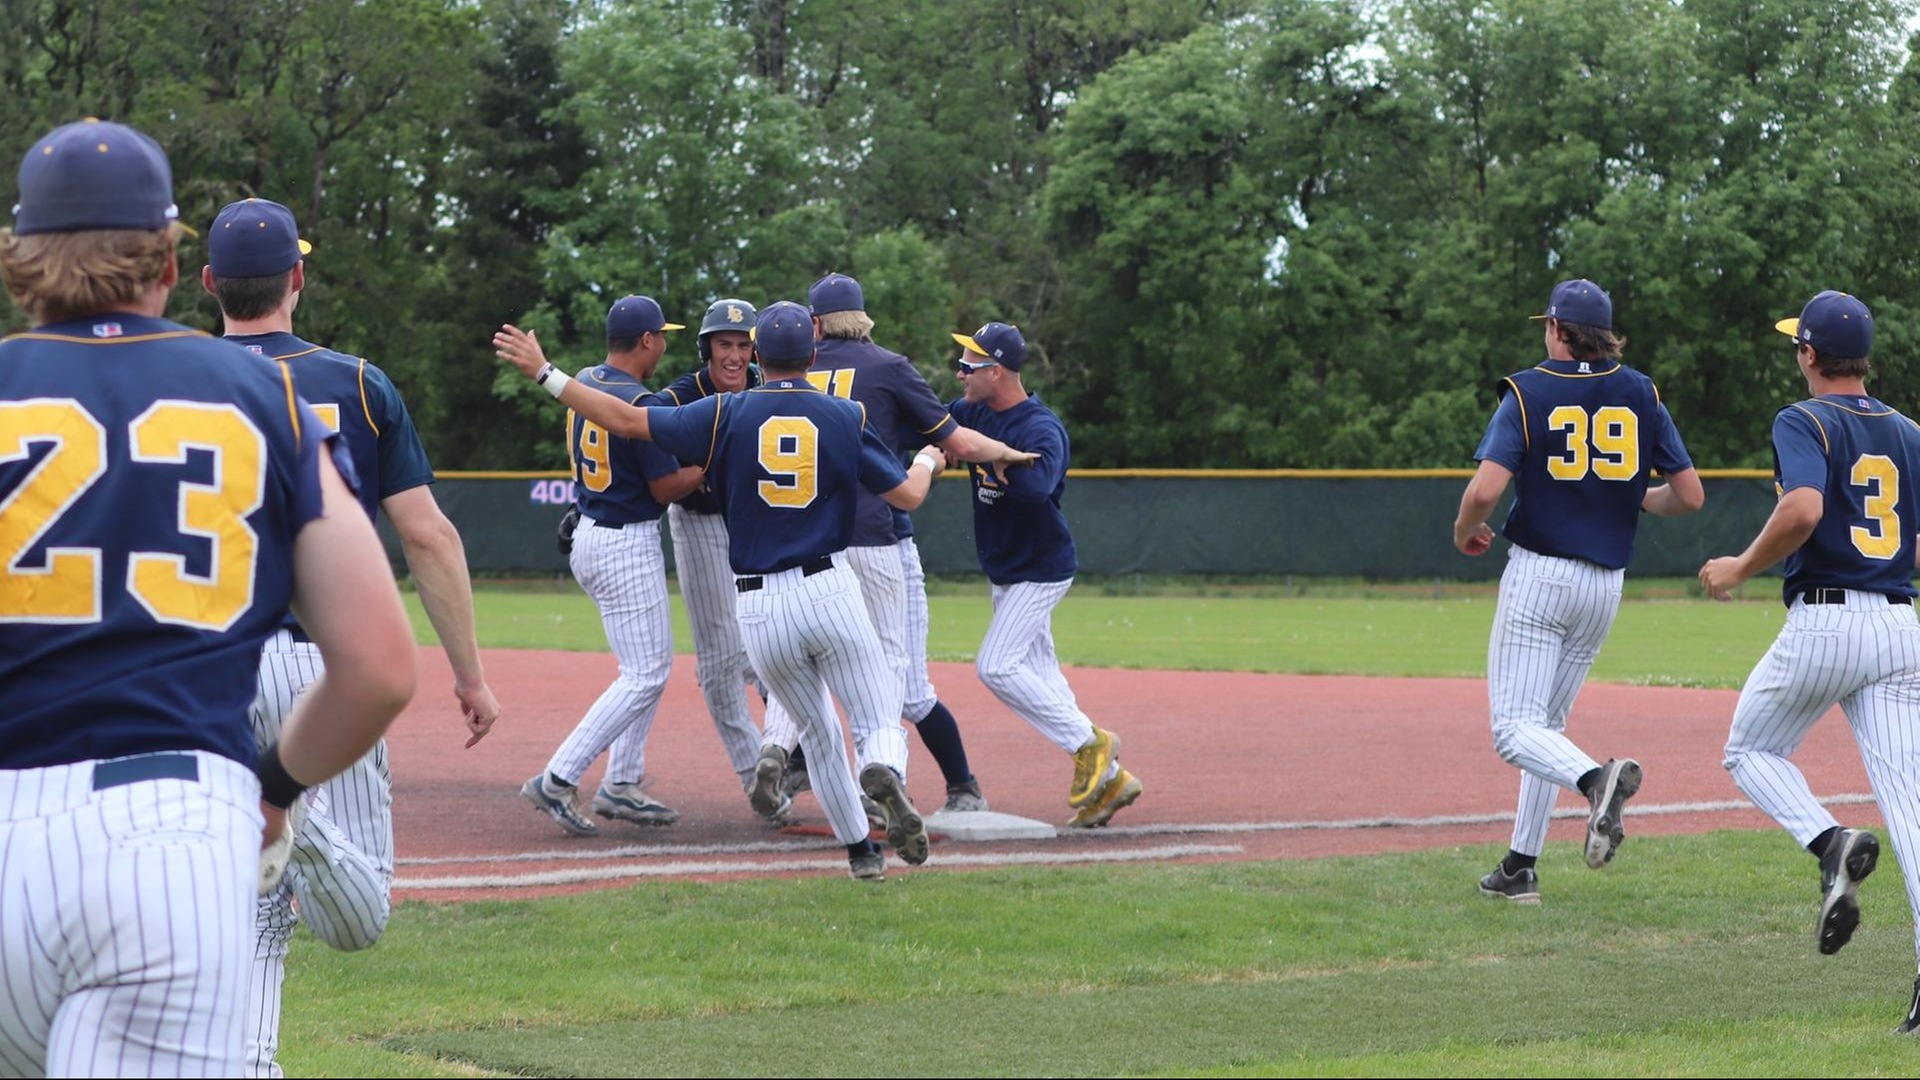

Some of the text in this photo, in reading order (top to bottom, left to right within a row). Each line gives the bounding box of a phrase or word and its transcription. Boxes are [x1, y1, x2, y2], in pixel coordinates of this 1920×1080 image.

[758, 415, 819, 509] 9
[1547, 405, 1639, 481] 39
[0, 397, 267, 632] 23
[1850, 453, 1901, 560] 3
